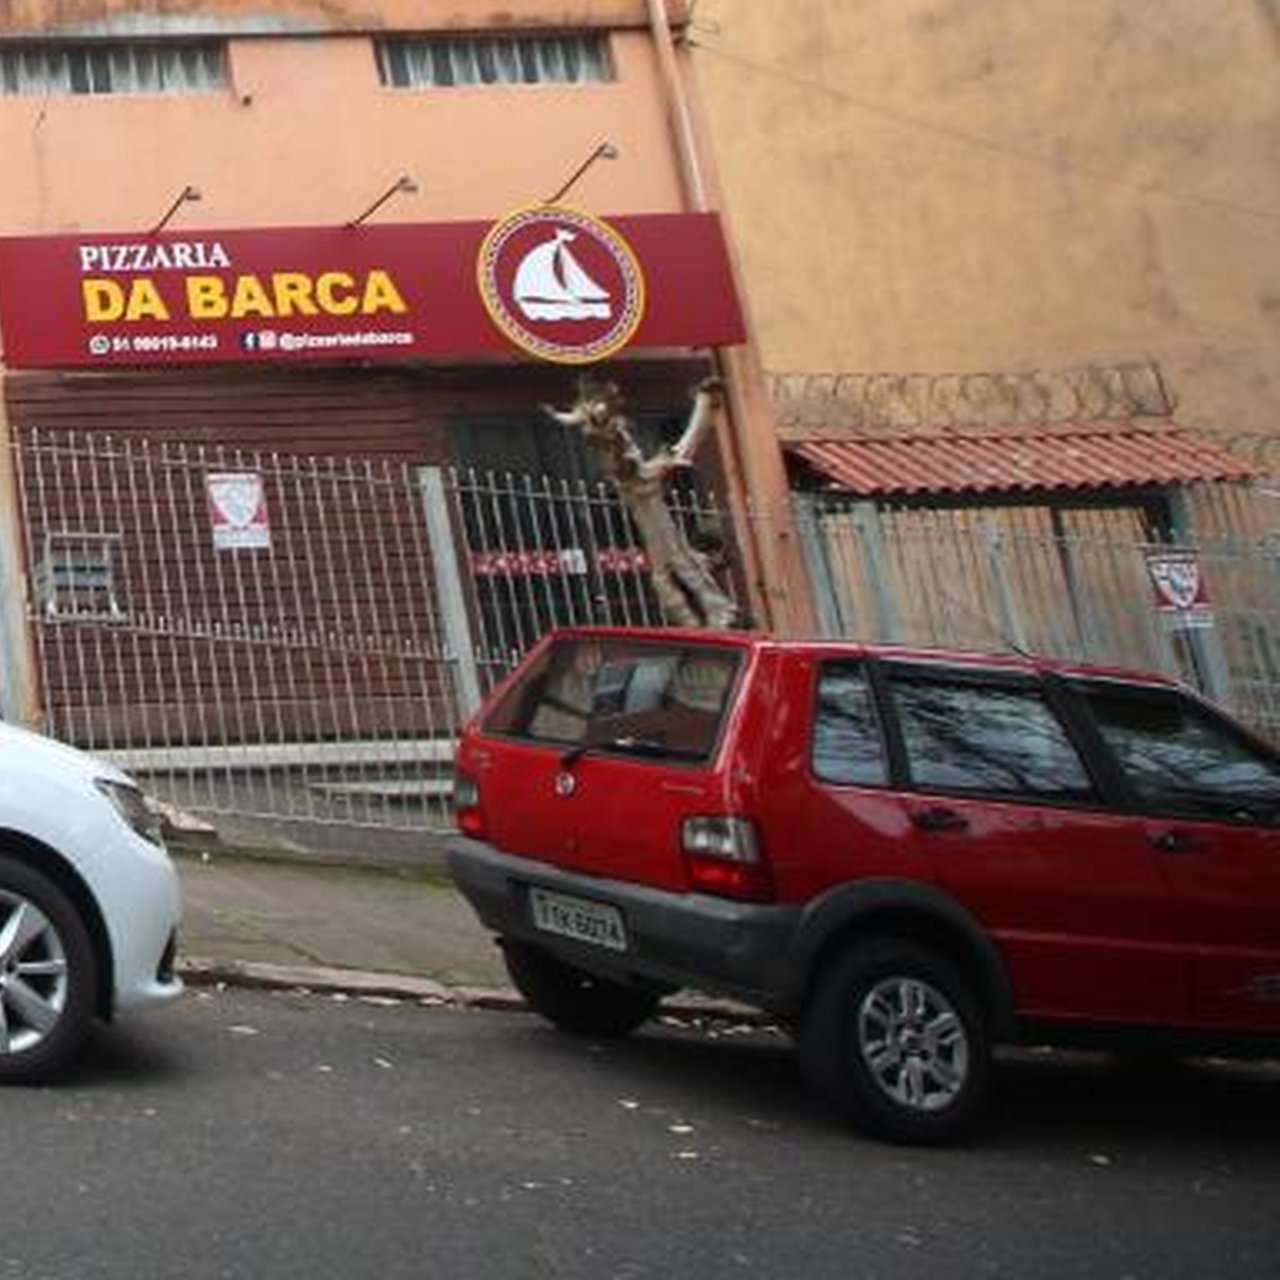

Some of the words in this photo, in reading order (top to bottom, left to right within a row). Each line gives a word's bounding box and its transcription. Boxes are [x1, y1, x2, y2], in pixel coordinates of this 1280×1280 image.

[79, 242, 231, 270] PIZZARIA
[82, 277, 171, 321] DA
[186, 270, 408, 319] BARCA
